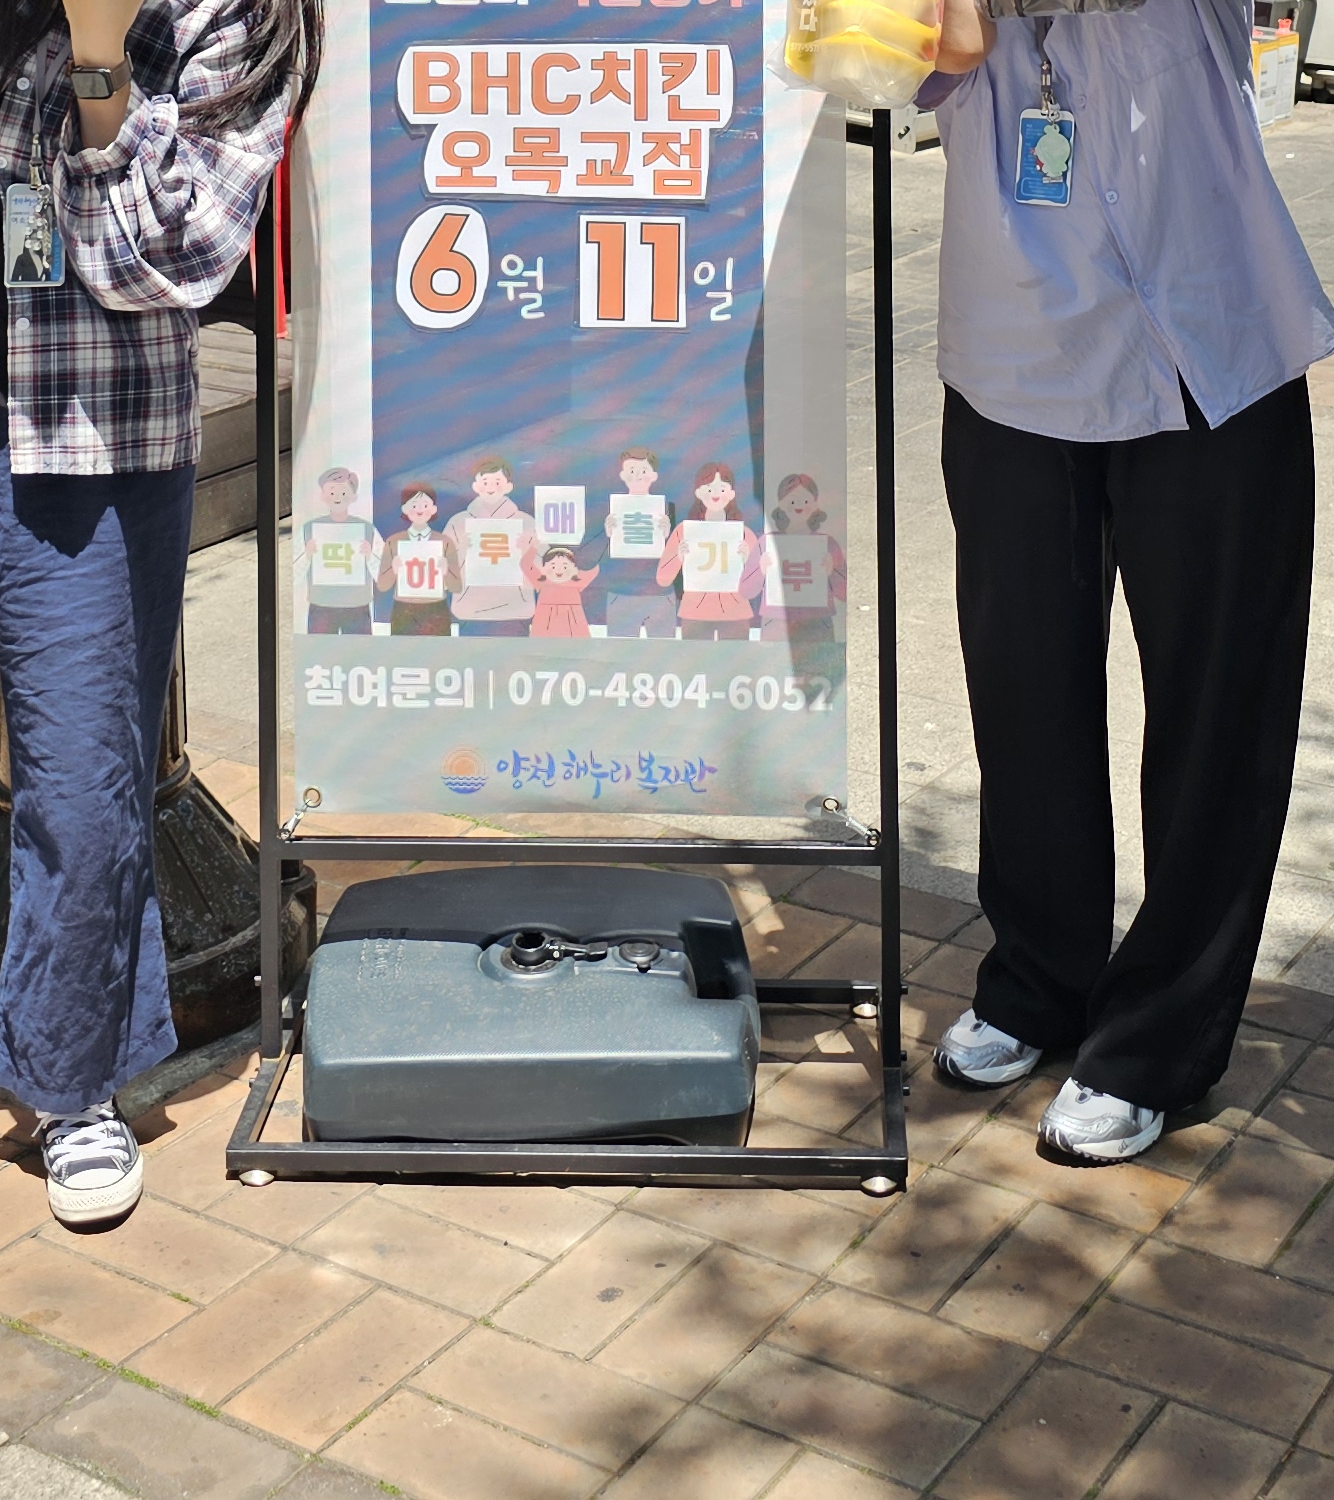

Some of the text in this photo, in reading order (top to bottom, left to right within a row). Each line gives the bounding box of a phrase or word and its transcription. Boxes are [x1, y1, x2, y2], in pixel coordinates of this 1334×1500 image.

[411, 48, 721, 122] BHC치킨
[435, 127, 702, 196] 오목교점
[321, 502, 814, 592] 딱 하 루 매 출 기 부
[304, 665, 835, 713] 참여문의 070-4804-6052
